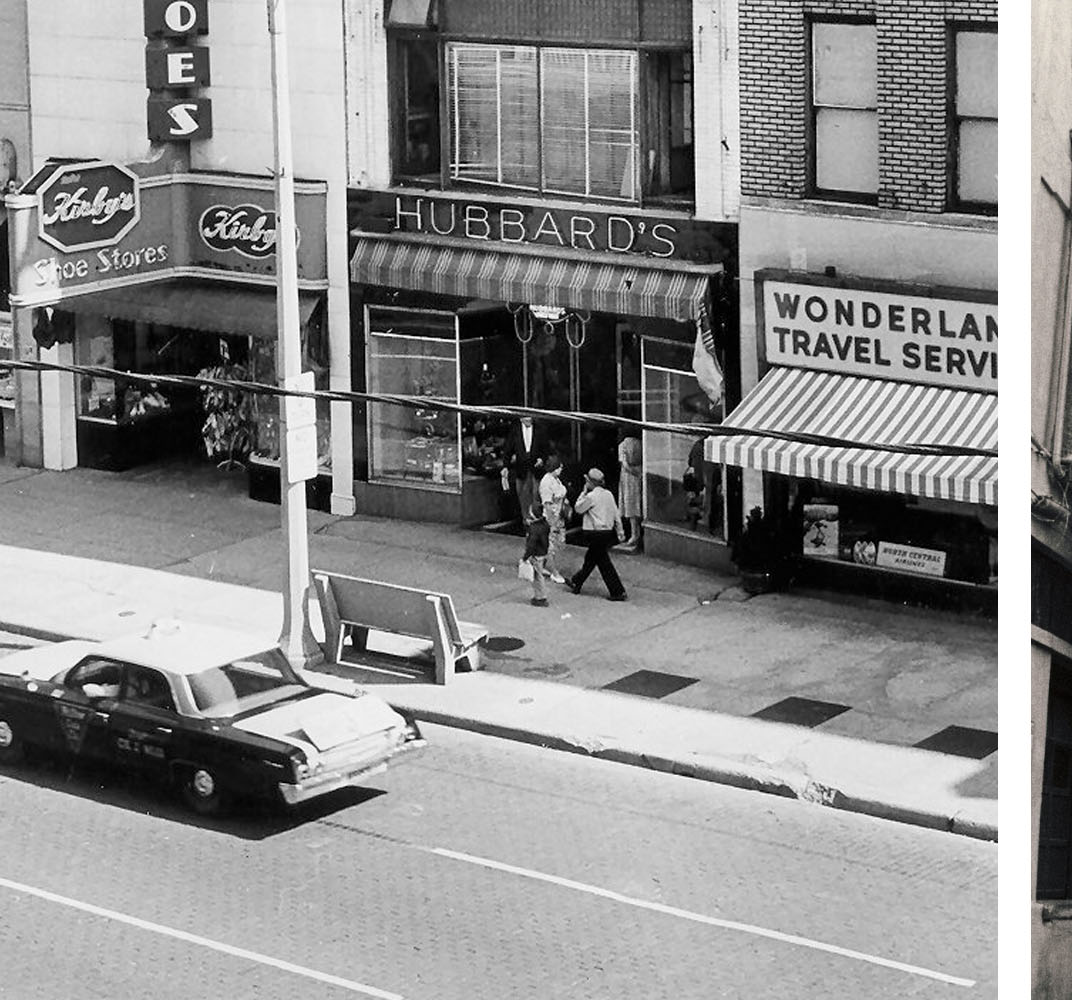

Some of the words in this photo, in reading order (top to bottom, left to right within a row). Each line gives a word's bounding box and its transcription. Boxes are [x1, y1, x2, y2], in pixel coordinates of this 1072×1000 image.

[41, 186, 138, 225] Kirby's
[394, 197, 677, 258] HUBBARD'S
[33, 256, 88, 287] Shoe
[96, 244, 168, 273] Stores
[773, 293, 998, 342] WONDERLAN
[773, 327, 891, 367] TRAVEL
[902, 342, 998, 379] SERVI
[909, 551, 941, 563] CENTRAL
